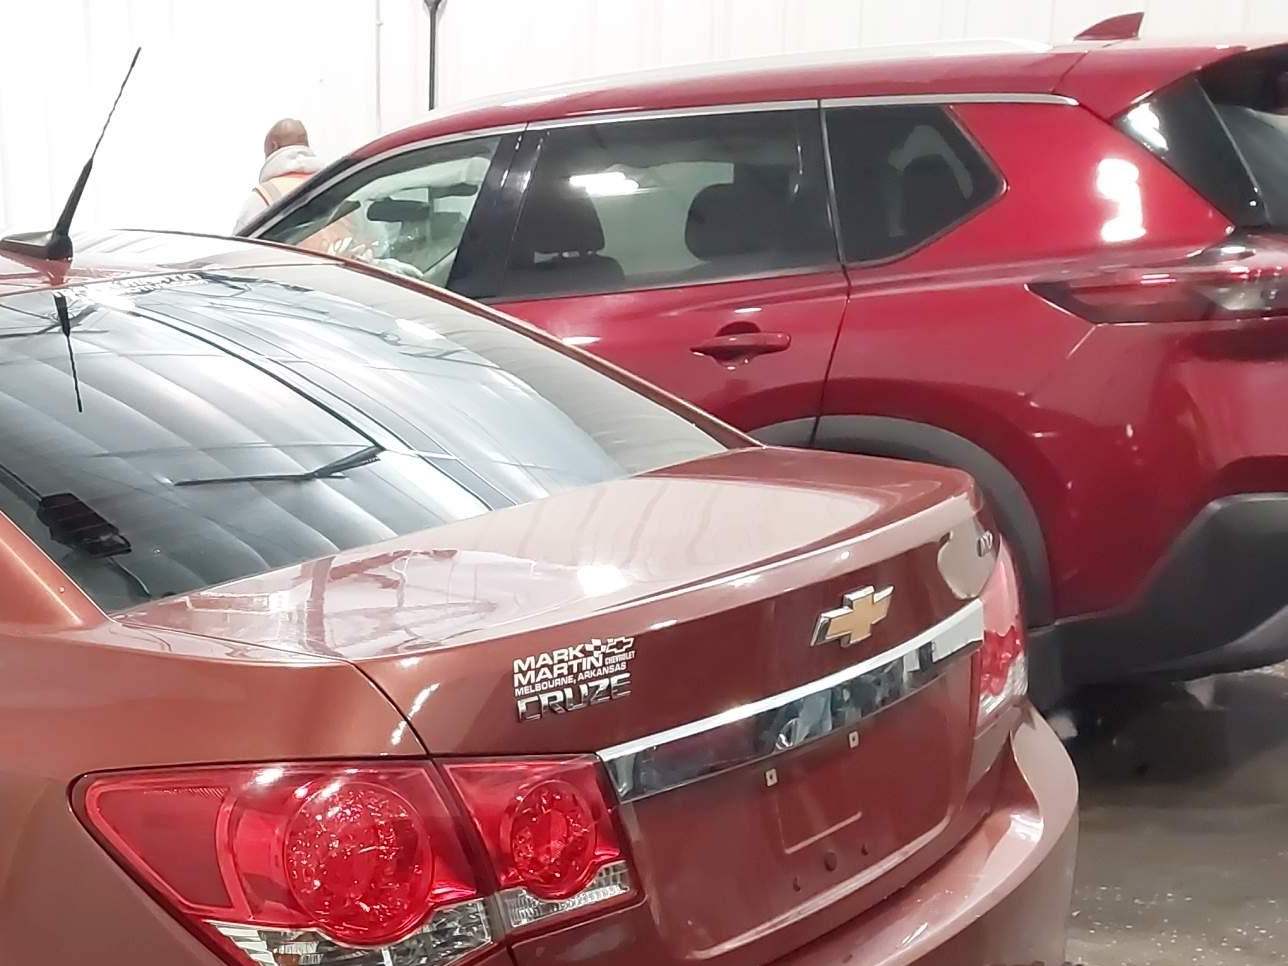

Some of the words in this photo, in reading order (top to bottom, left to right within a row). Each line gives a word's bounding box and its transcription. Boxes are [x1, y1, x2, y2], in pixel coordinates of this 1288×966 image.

[513, 644, 584, 673] MARK
[513, 654, 603, 687] MARTIN
[514, 675, 577, 697] MELBOURNE,
[577, 661, 627, 682] ARKANSAS
[517, 672, 632, 722] CRUZE
